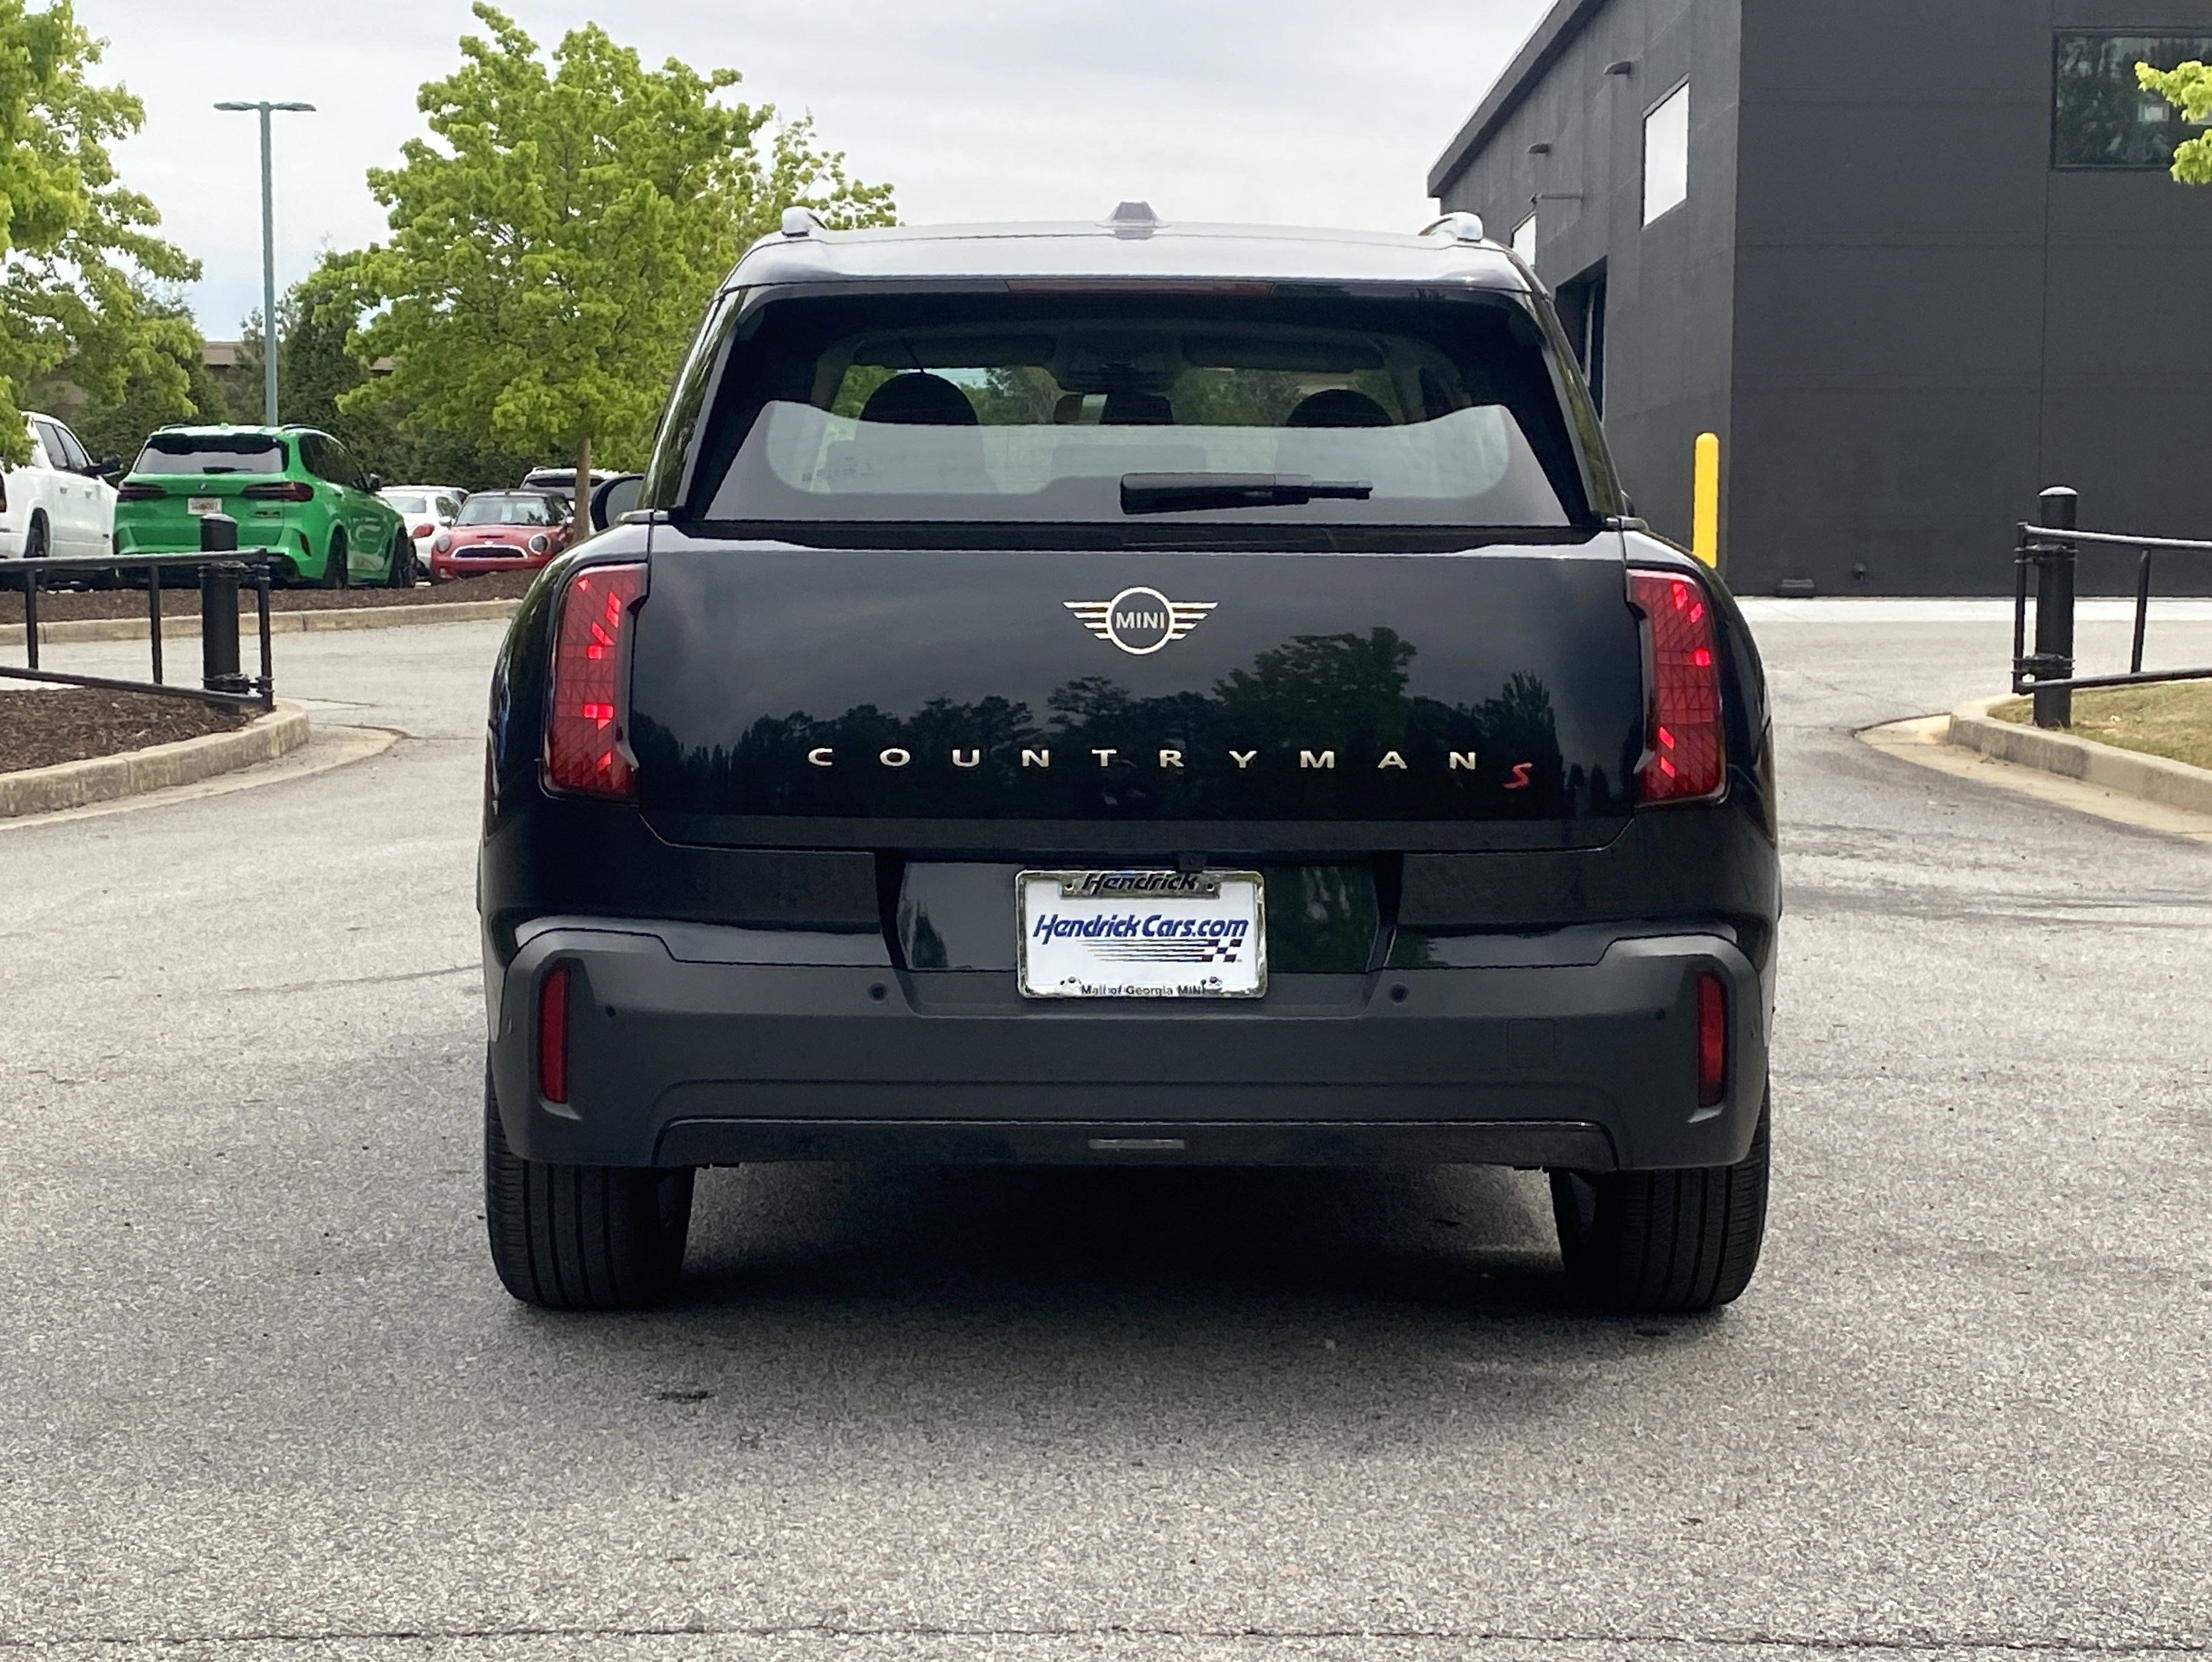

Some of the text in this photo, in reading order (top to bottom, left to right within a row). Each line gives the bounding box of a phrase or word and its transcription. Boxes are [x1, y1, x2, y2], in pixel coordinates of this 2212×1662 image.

[1116, 611, 1165, 629] MINI
[807, 747, 1533, 789] COUNTRYMAN S
[1081, 872, 1198, 896] Hendrick
[1081, 984, 1206, 996] Mall of Georgia MINI
